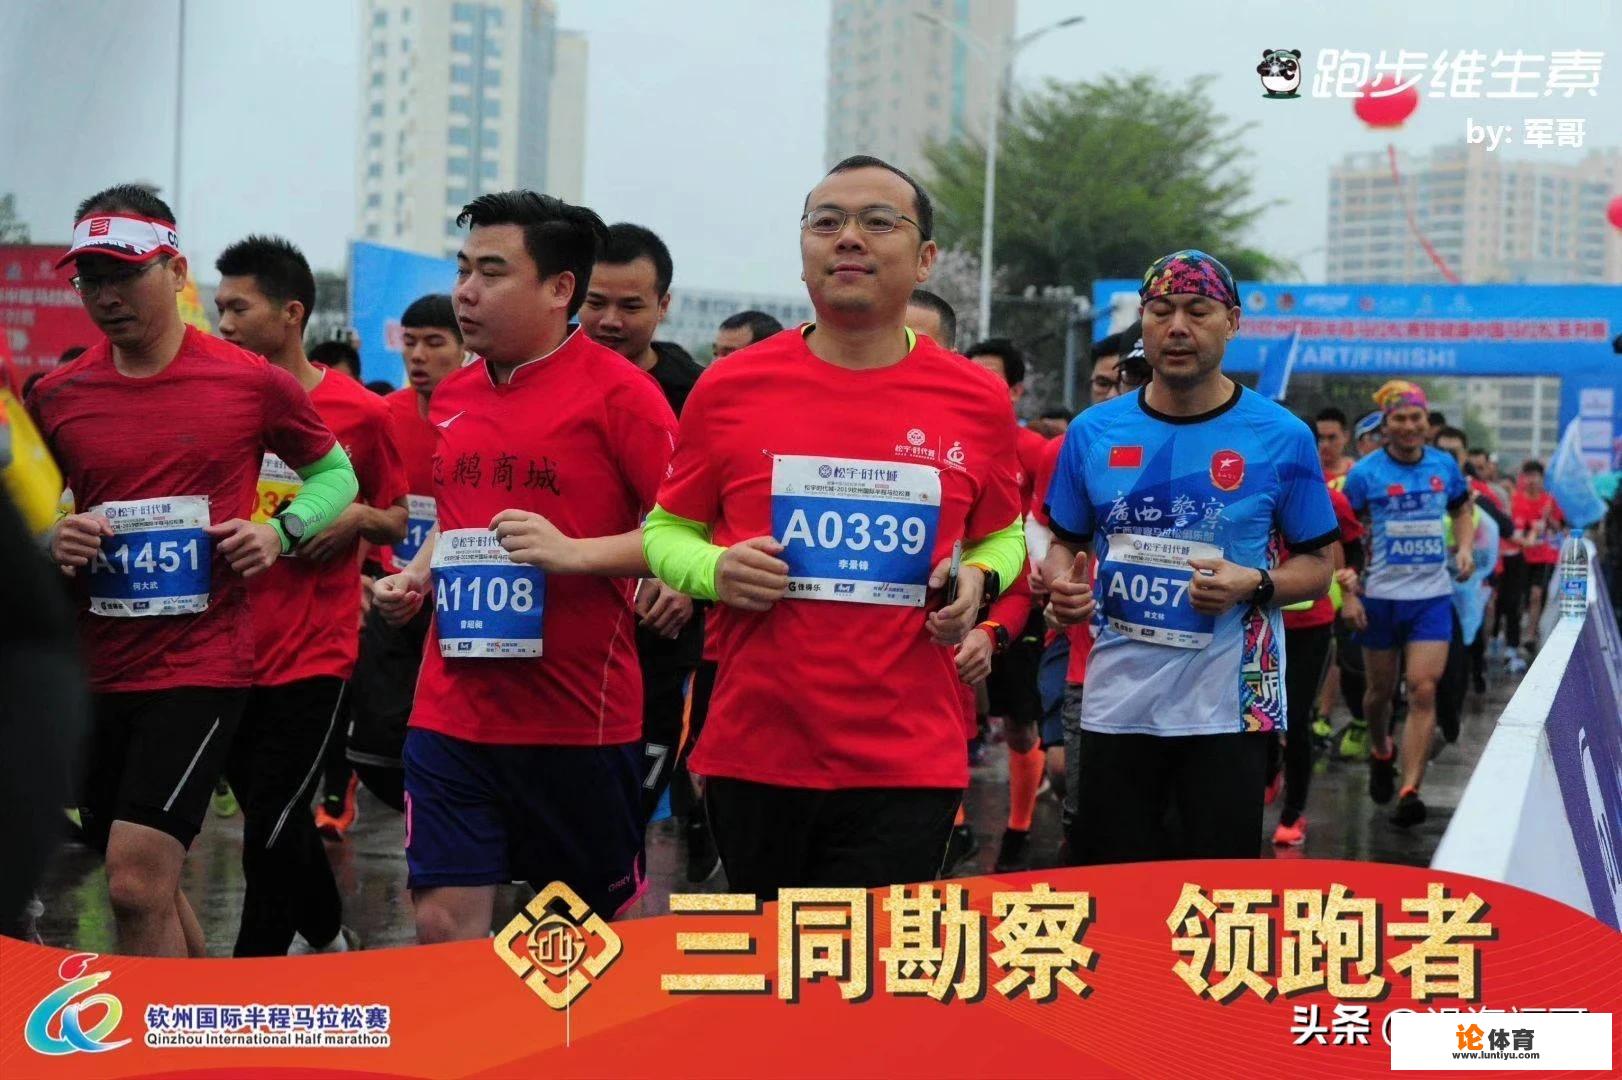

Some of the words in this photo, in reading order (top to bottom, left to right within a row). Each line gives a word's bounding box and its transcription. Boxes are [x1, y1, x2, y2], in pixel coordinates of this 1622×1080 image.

[432, 452, 561, 496] 飞鹅商城
[781, 508, 926, 555] A0339
[91, 539, 199, 574] A1451
[436, 577, 533, 612] A1108
[1108, 570, 1191, 608] A057
